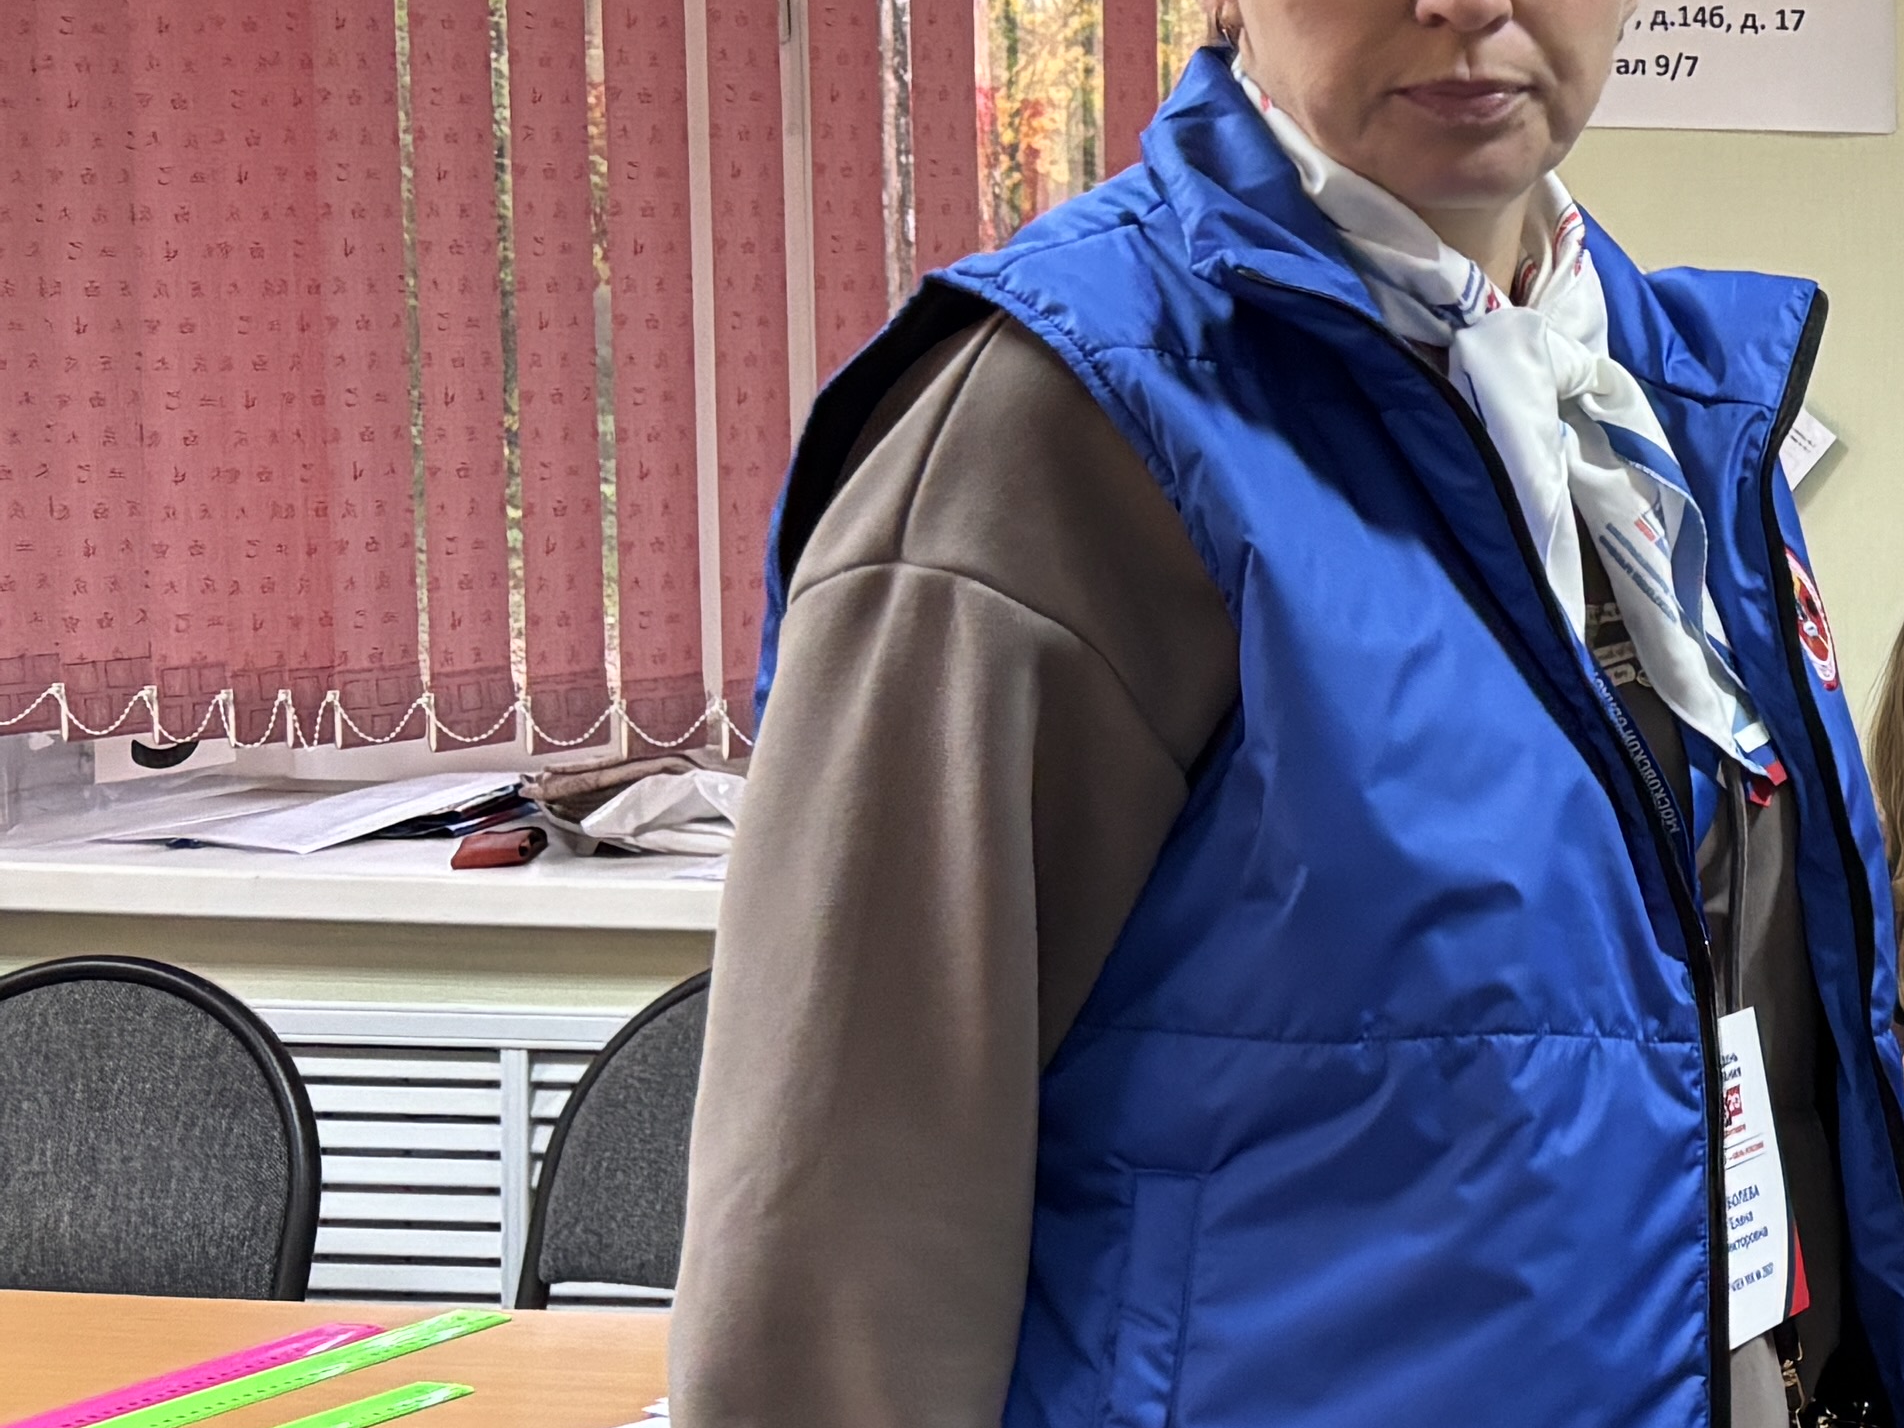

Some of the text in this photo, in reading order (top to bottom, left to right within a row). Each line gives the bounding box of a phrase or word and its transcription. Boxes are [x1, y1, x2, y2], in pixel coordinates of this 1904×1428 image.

[1740, 13, 1766, 34] д.
[1775, 9, 1806, 31] 17
[1655, 52, 1699, 81] 9/7
[1727, 1184, 1760, 1210] БОЛЕВА
